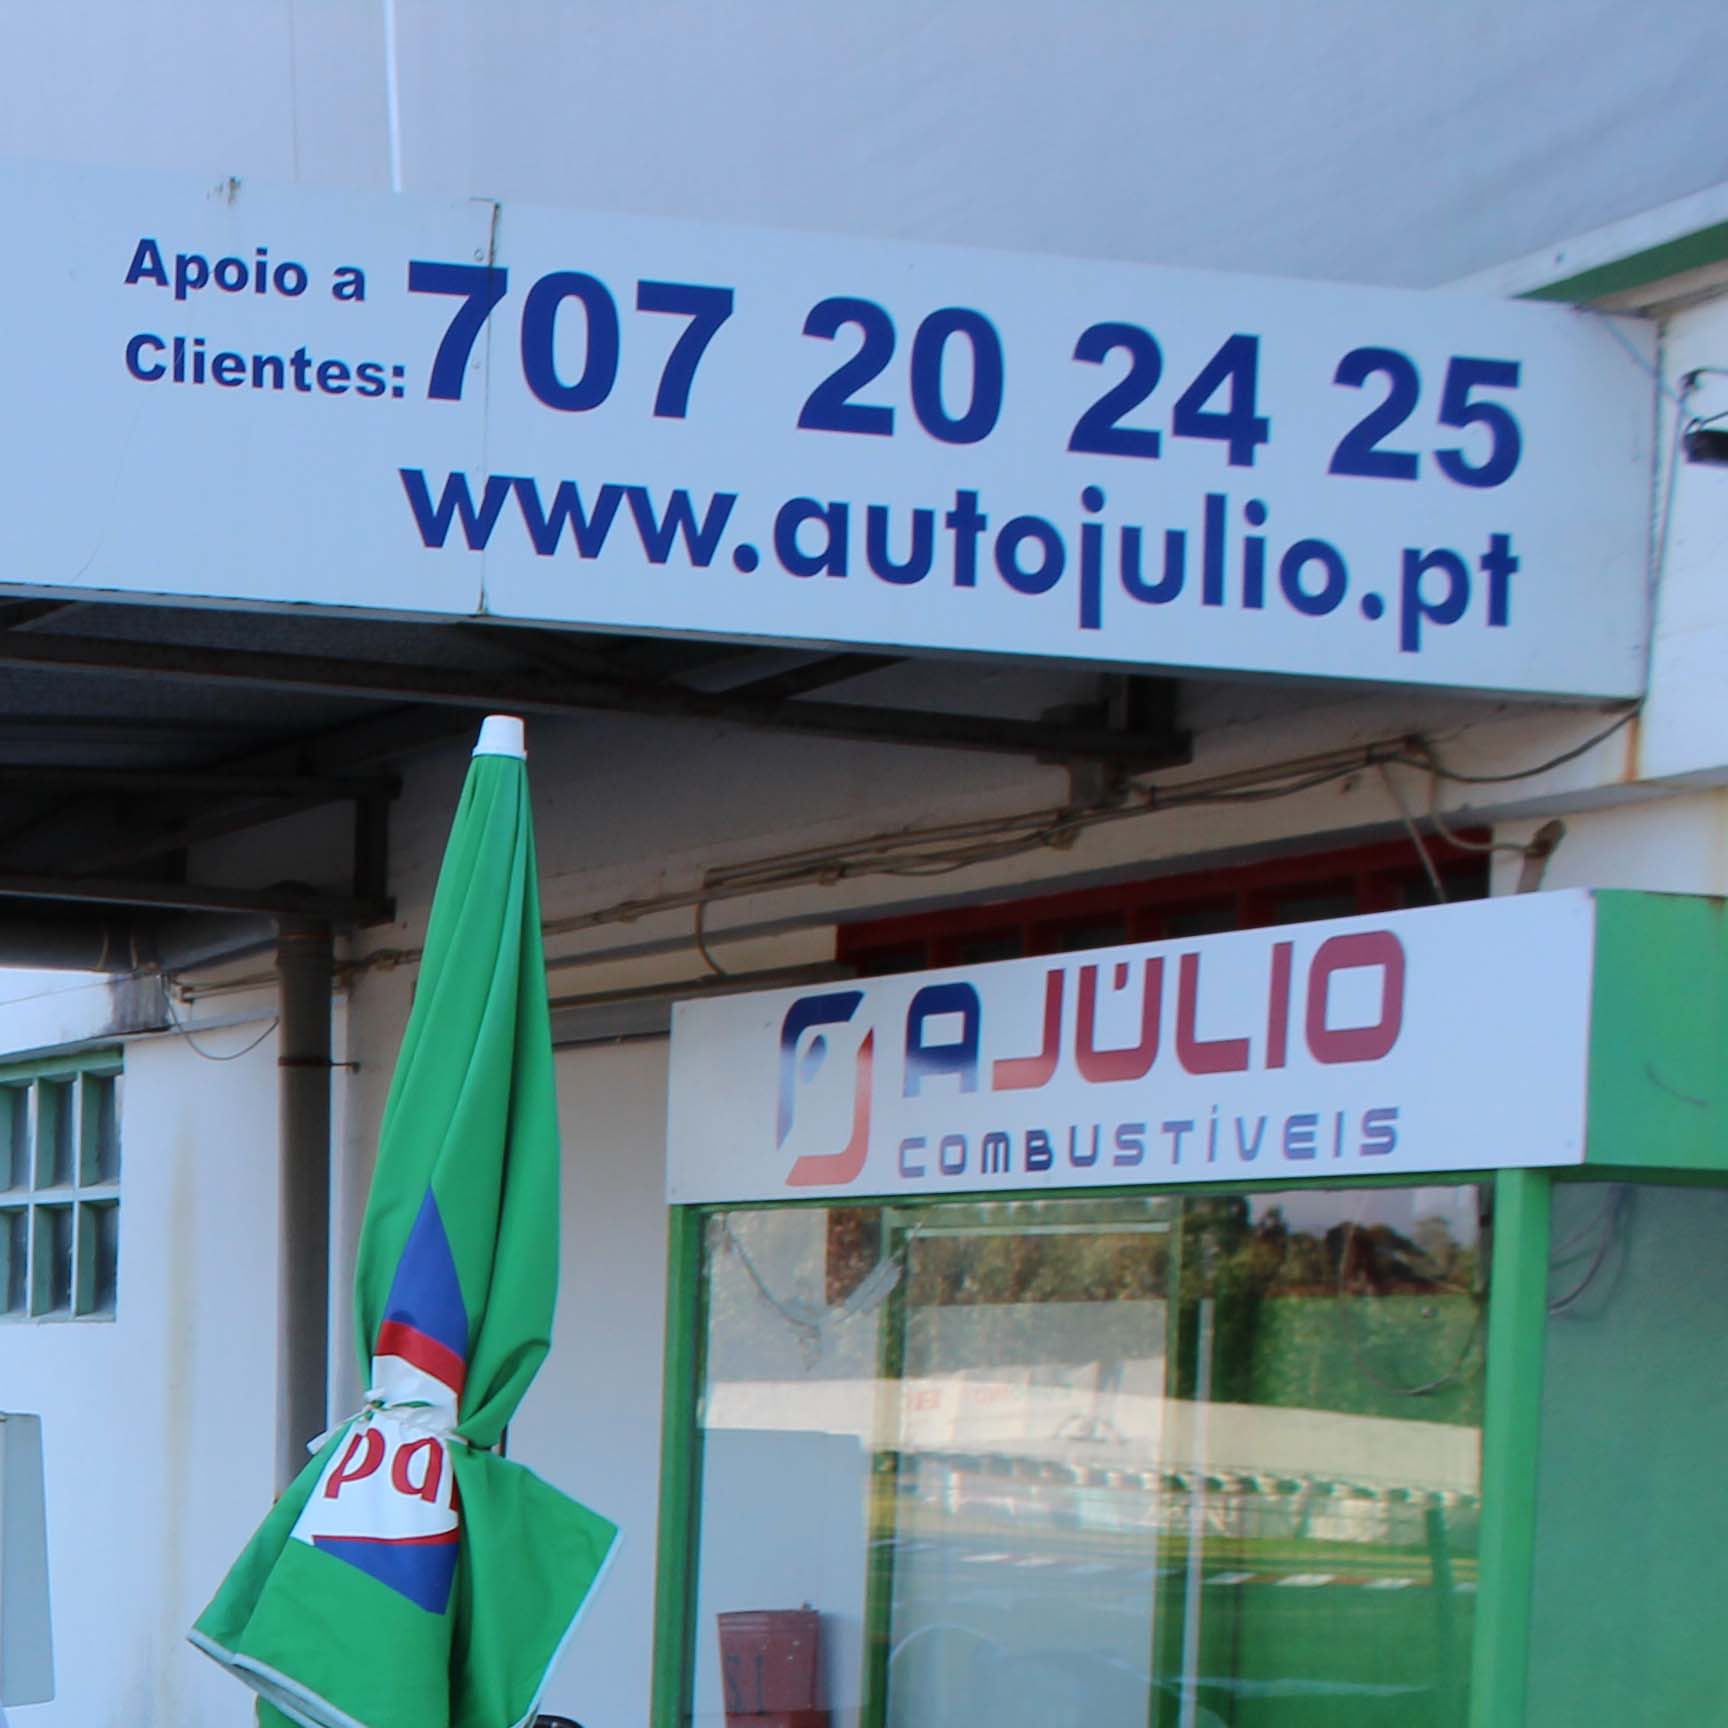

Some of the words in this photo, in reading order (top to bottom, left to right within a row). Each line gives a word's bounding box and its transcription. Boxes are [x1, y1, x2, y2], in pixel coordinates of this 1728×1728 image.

[124, 237, 310, 302] Apoio
[332, 265, 367, 302] a
[125, 332, 407, 399] Clientes:
[408, 258, 736, 420] 707
[797, 295, 1006, 446] 20
[1068, 320, 1272, 468] 24
[1328, 345, 1525, 489] 25
[399, 464, 1522, 655] www.autojulio.pt
[324, 1427, 459, 1513] pa
